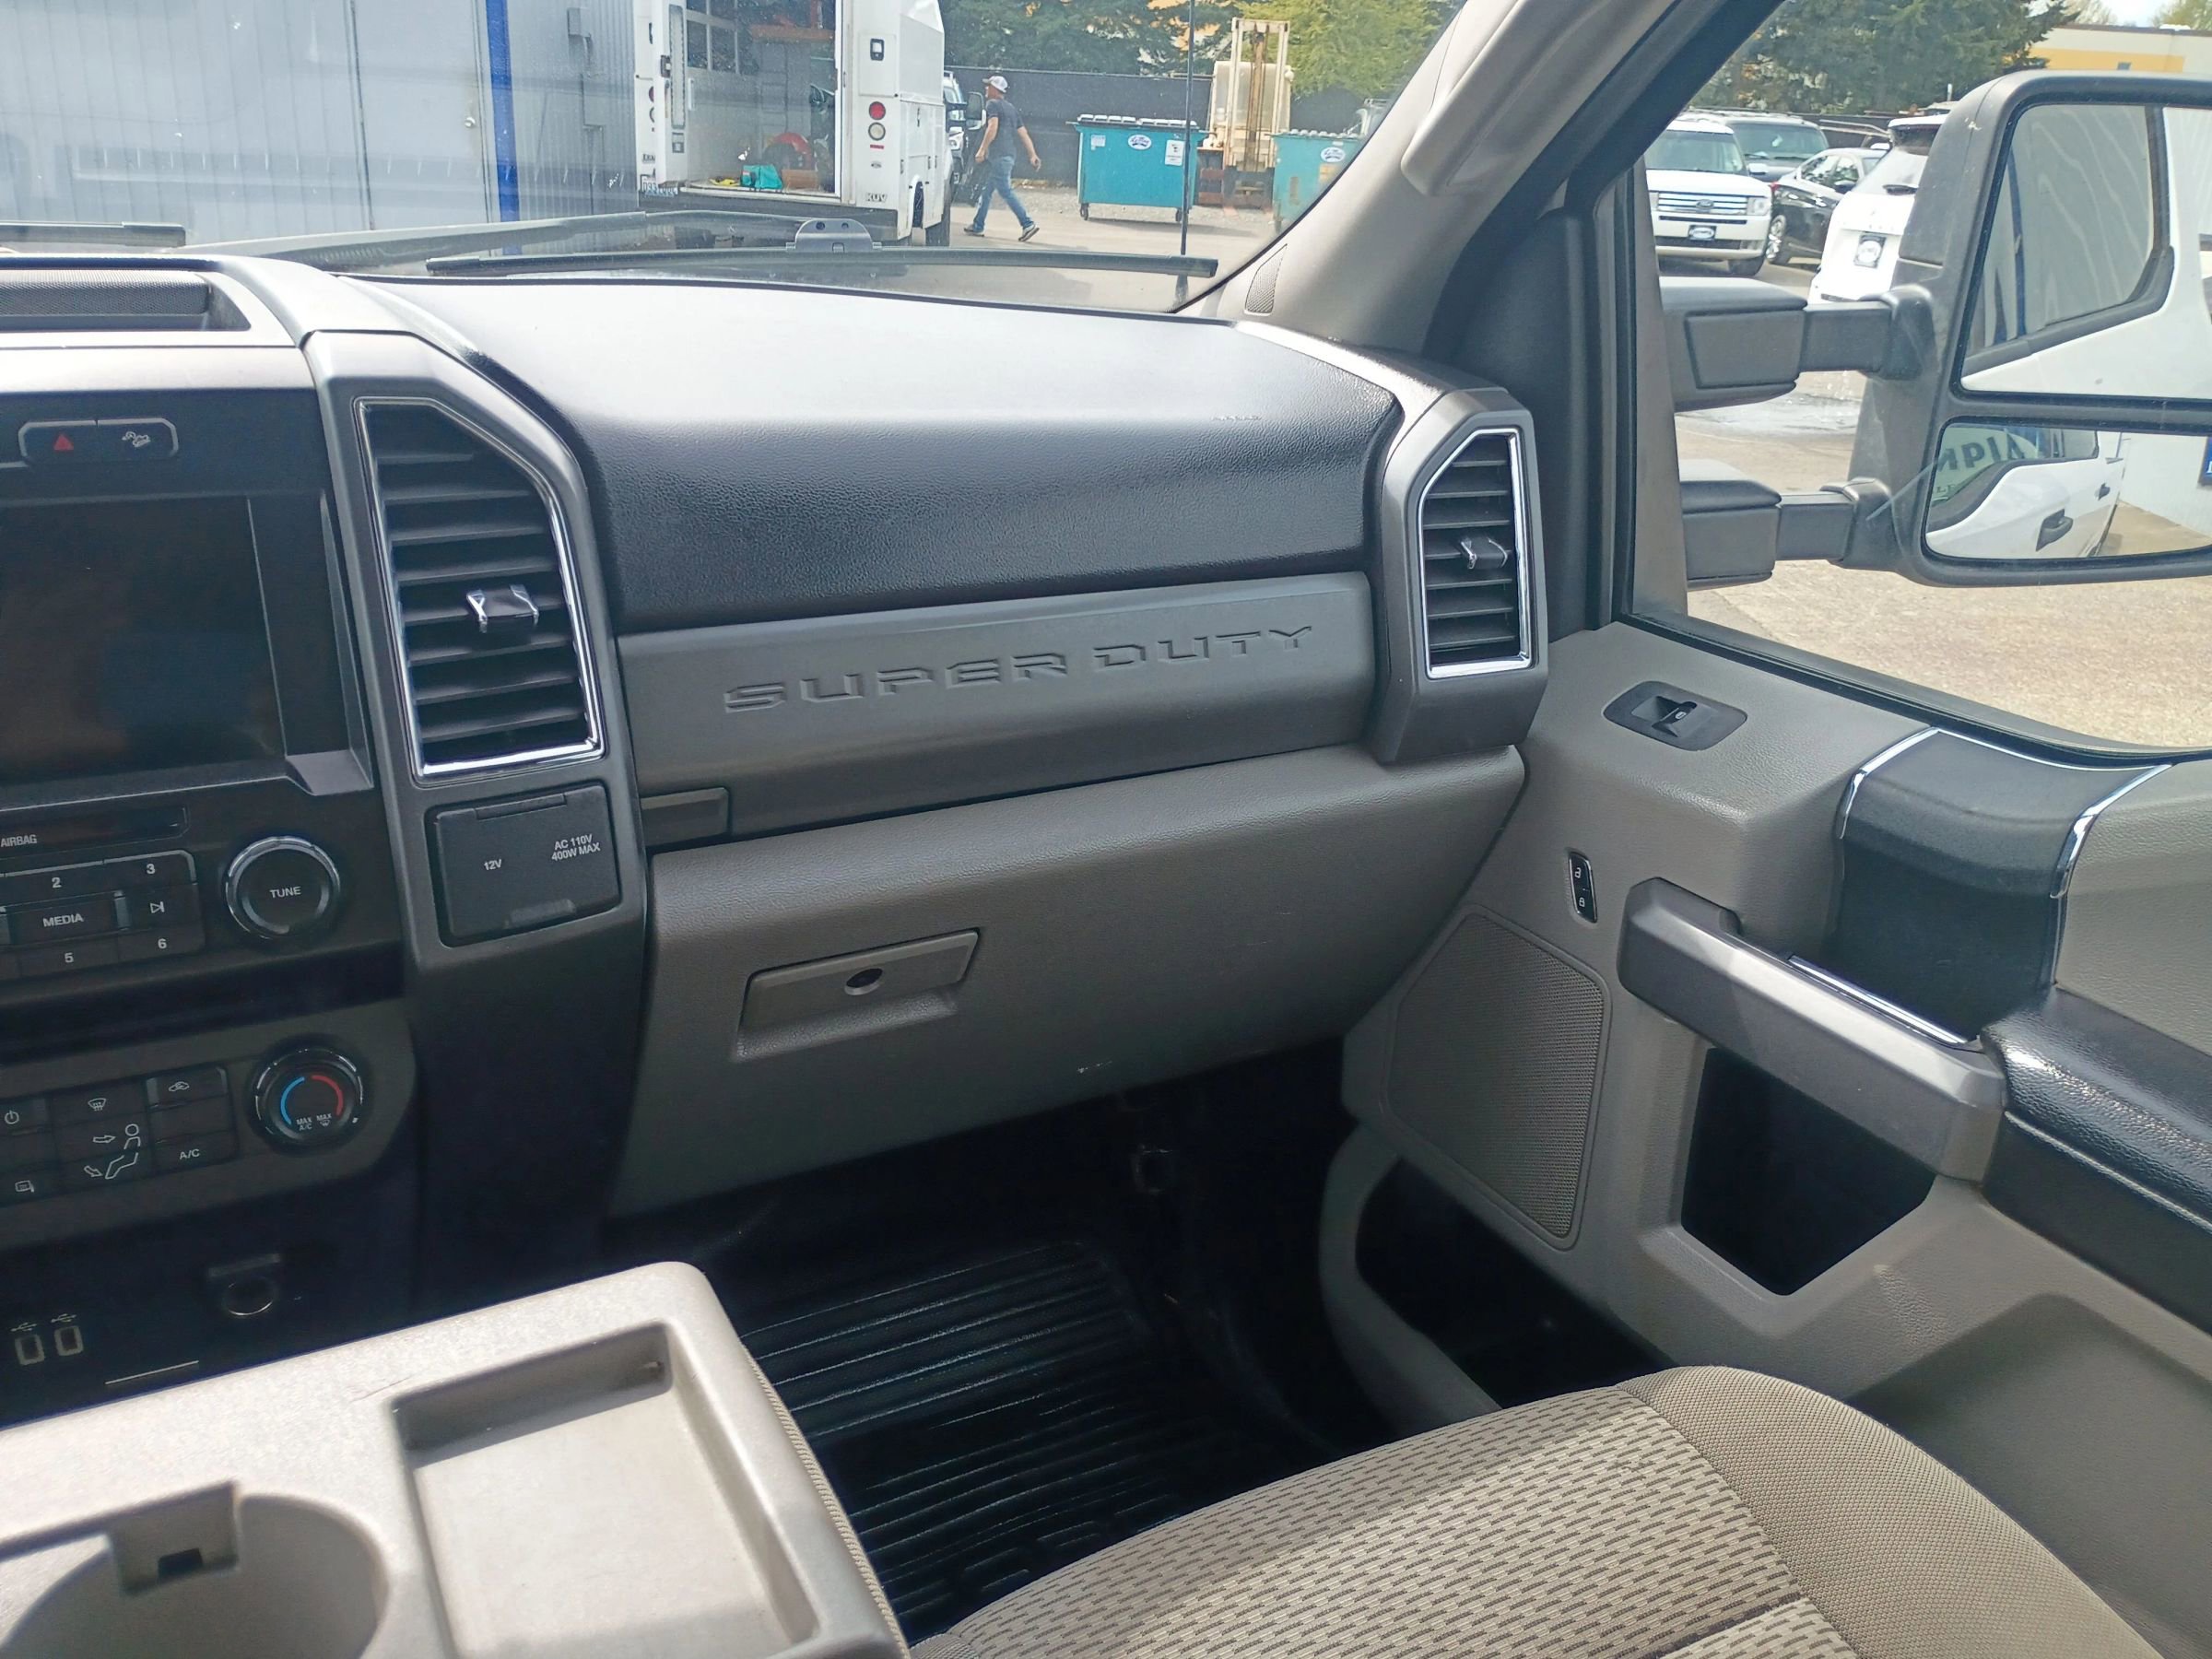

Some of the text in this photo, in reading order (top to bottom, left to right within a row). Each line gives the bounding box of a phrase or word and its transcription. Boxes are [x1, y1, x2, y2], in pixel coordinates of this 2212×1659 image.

[724, 625, 1313, 713] SUPER DUTY
[0, 833, 38, 847] AIRBAG
[554, 833, 593, 850] AC 110V
[551, 842, 601, 861] 400W MAX
[147, 864, 156, 875] 3
[483, 859, 502, 871] 12V
[52, 877, 62, 888] 2
[270, 886, 302, 899] TUNE
[42, 912, 84, 928] MEDIA
[158, 937, 167, 950] 6
[65, 952, 74, 964] 5
[180, 1148, 200, 1159] A/C
